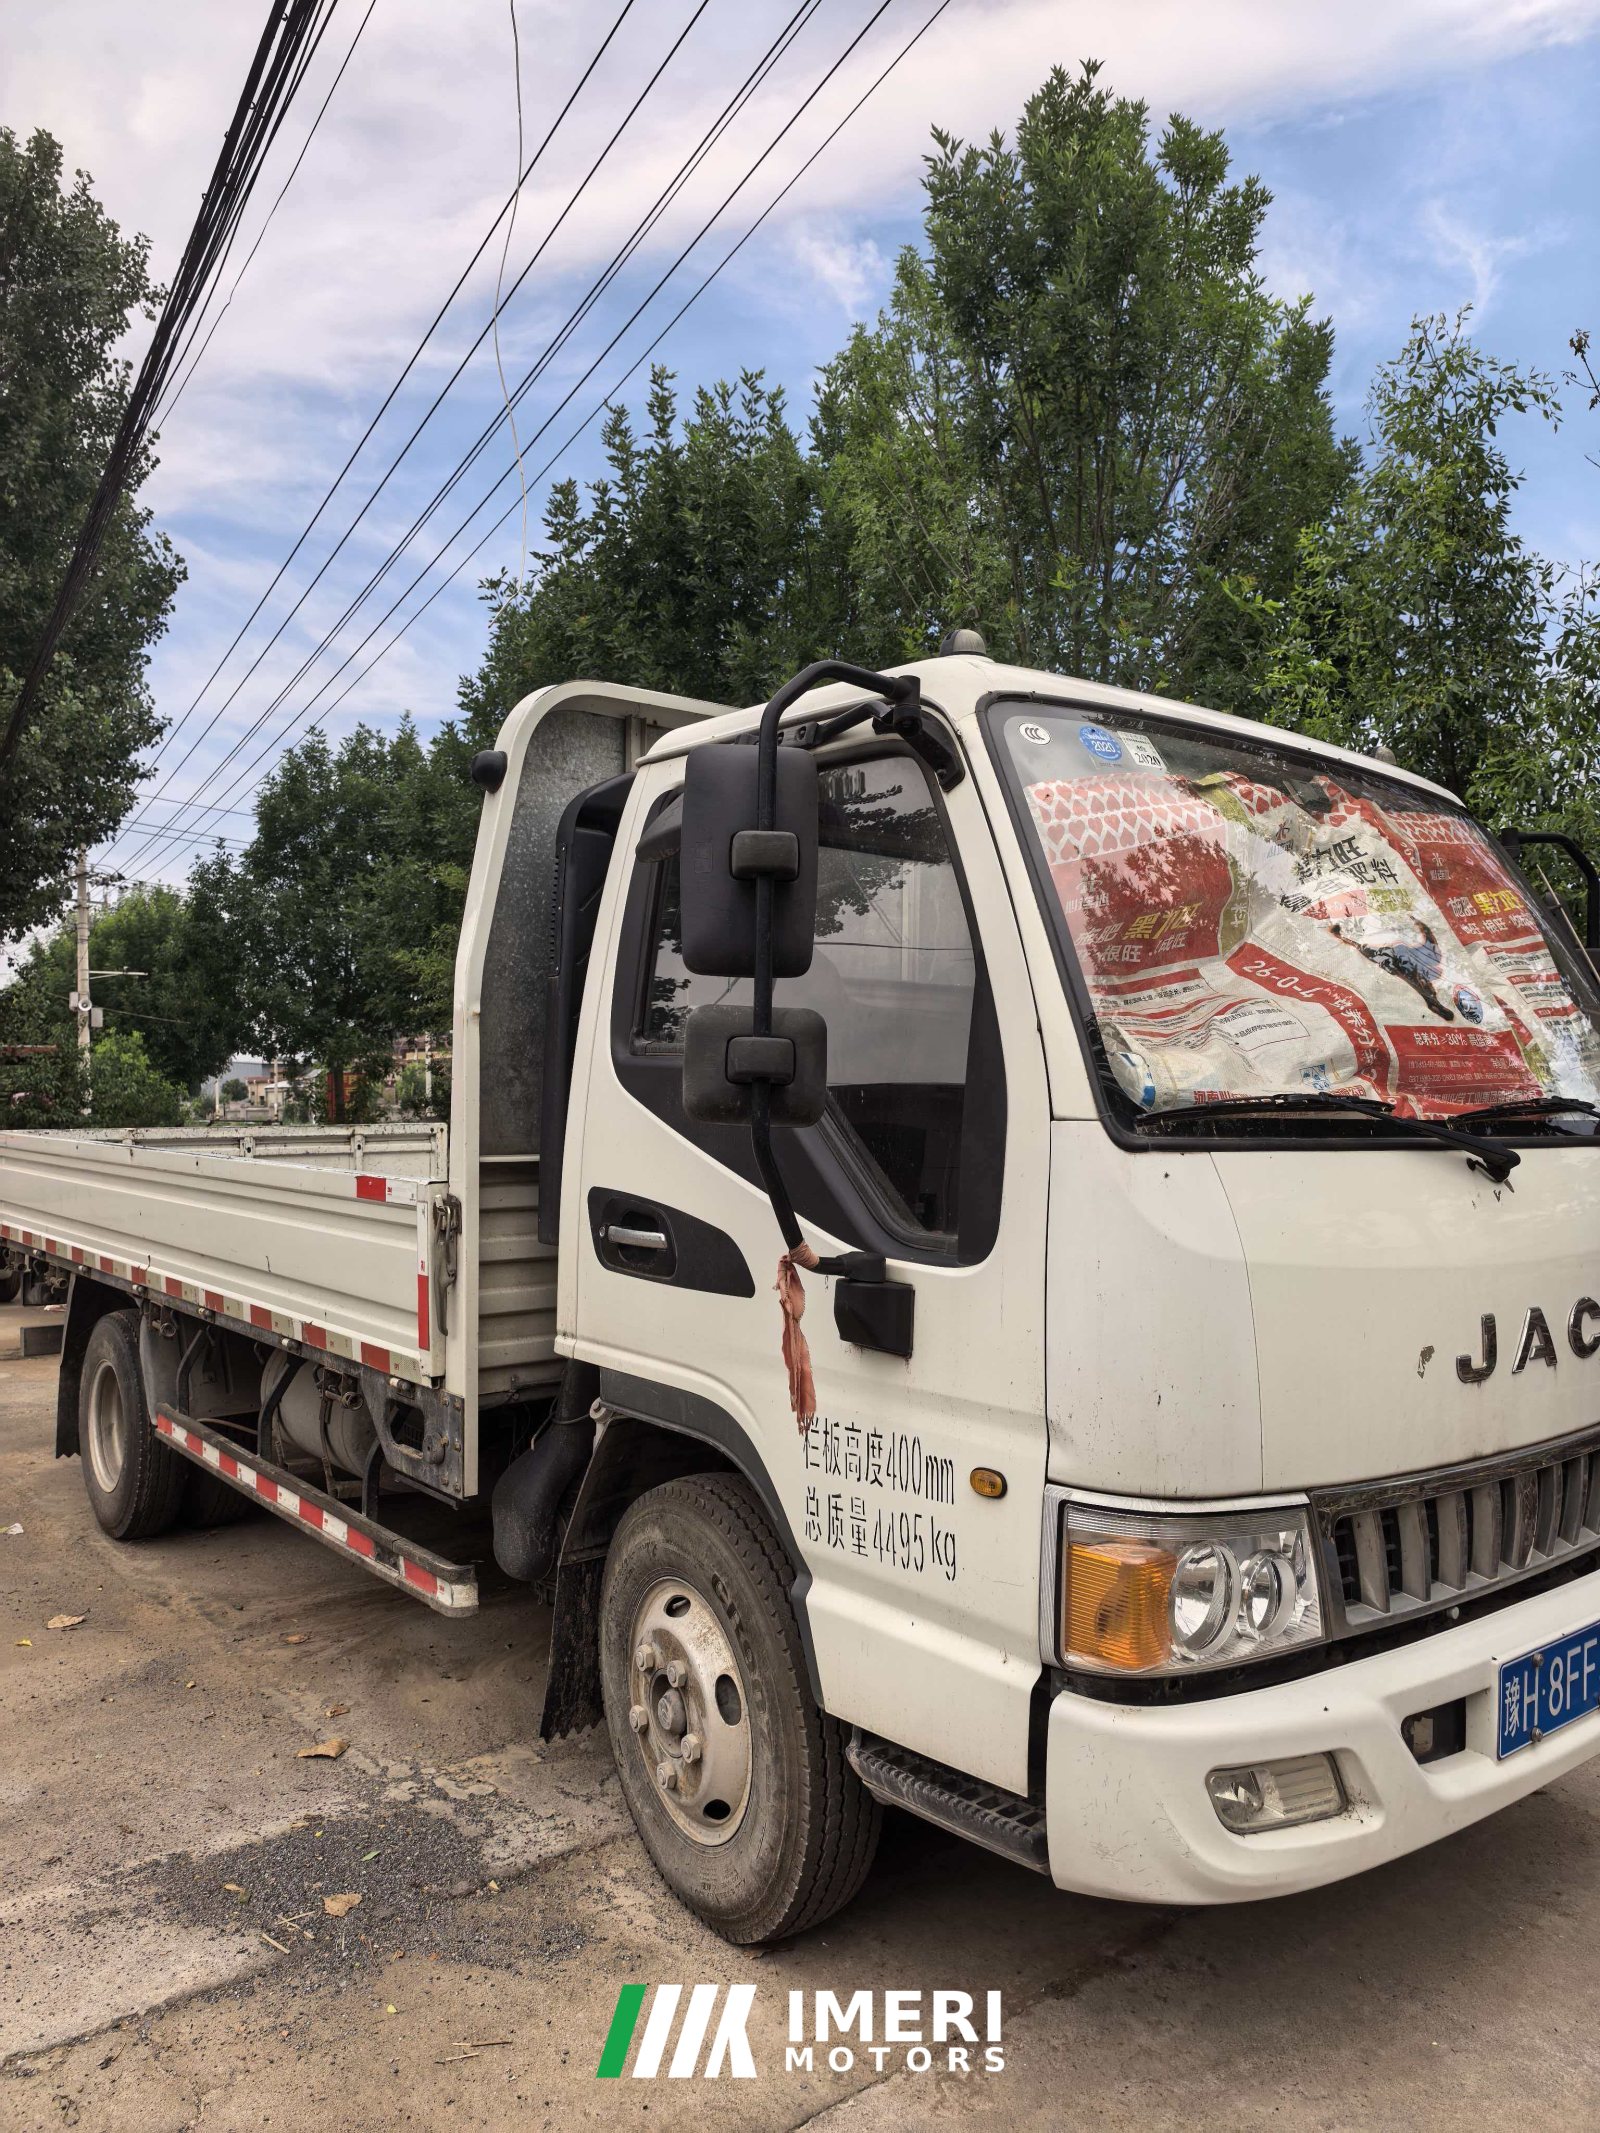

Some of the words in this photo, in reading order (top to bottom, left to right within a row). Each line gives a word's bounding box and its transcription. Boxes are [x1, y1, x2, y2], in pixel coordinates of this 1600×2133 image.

[1092, 740, 1115, 753] 2020
[1135, 753, 1162, 767] 2020
[1456, 1296, 1600, 1384] JAC
[805, 1486, 956, 1581] 总质量4495kg
